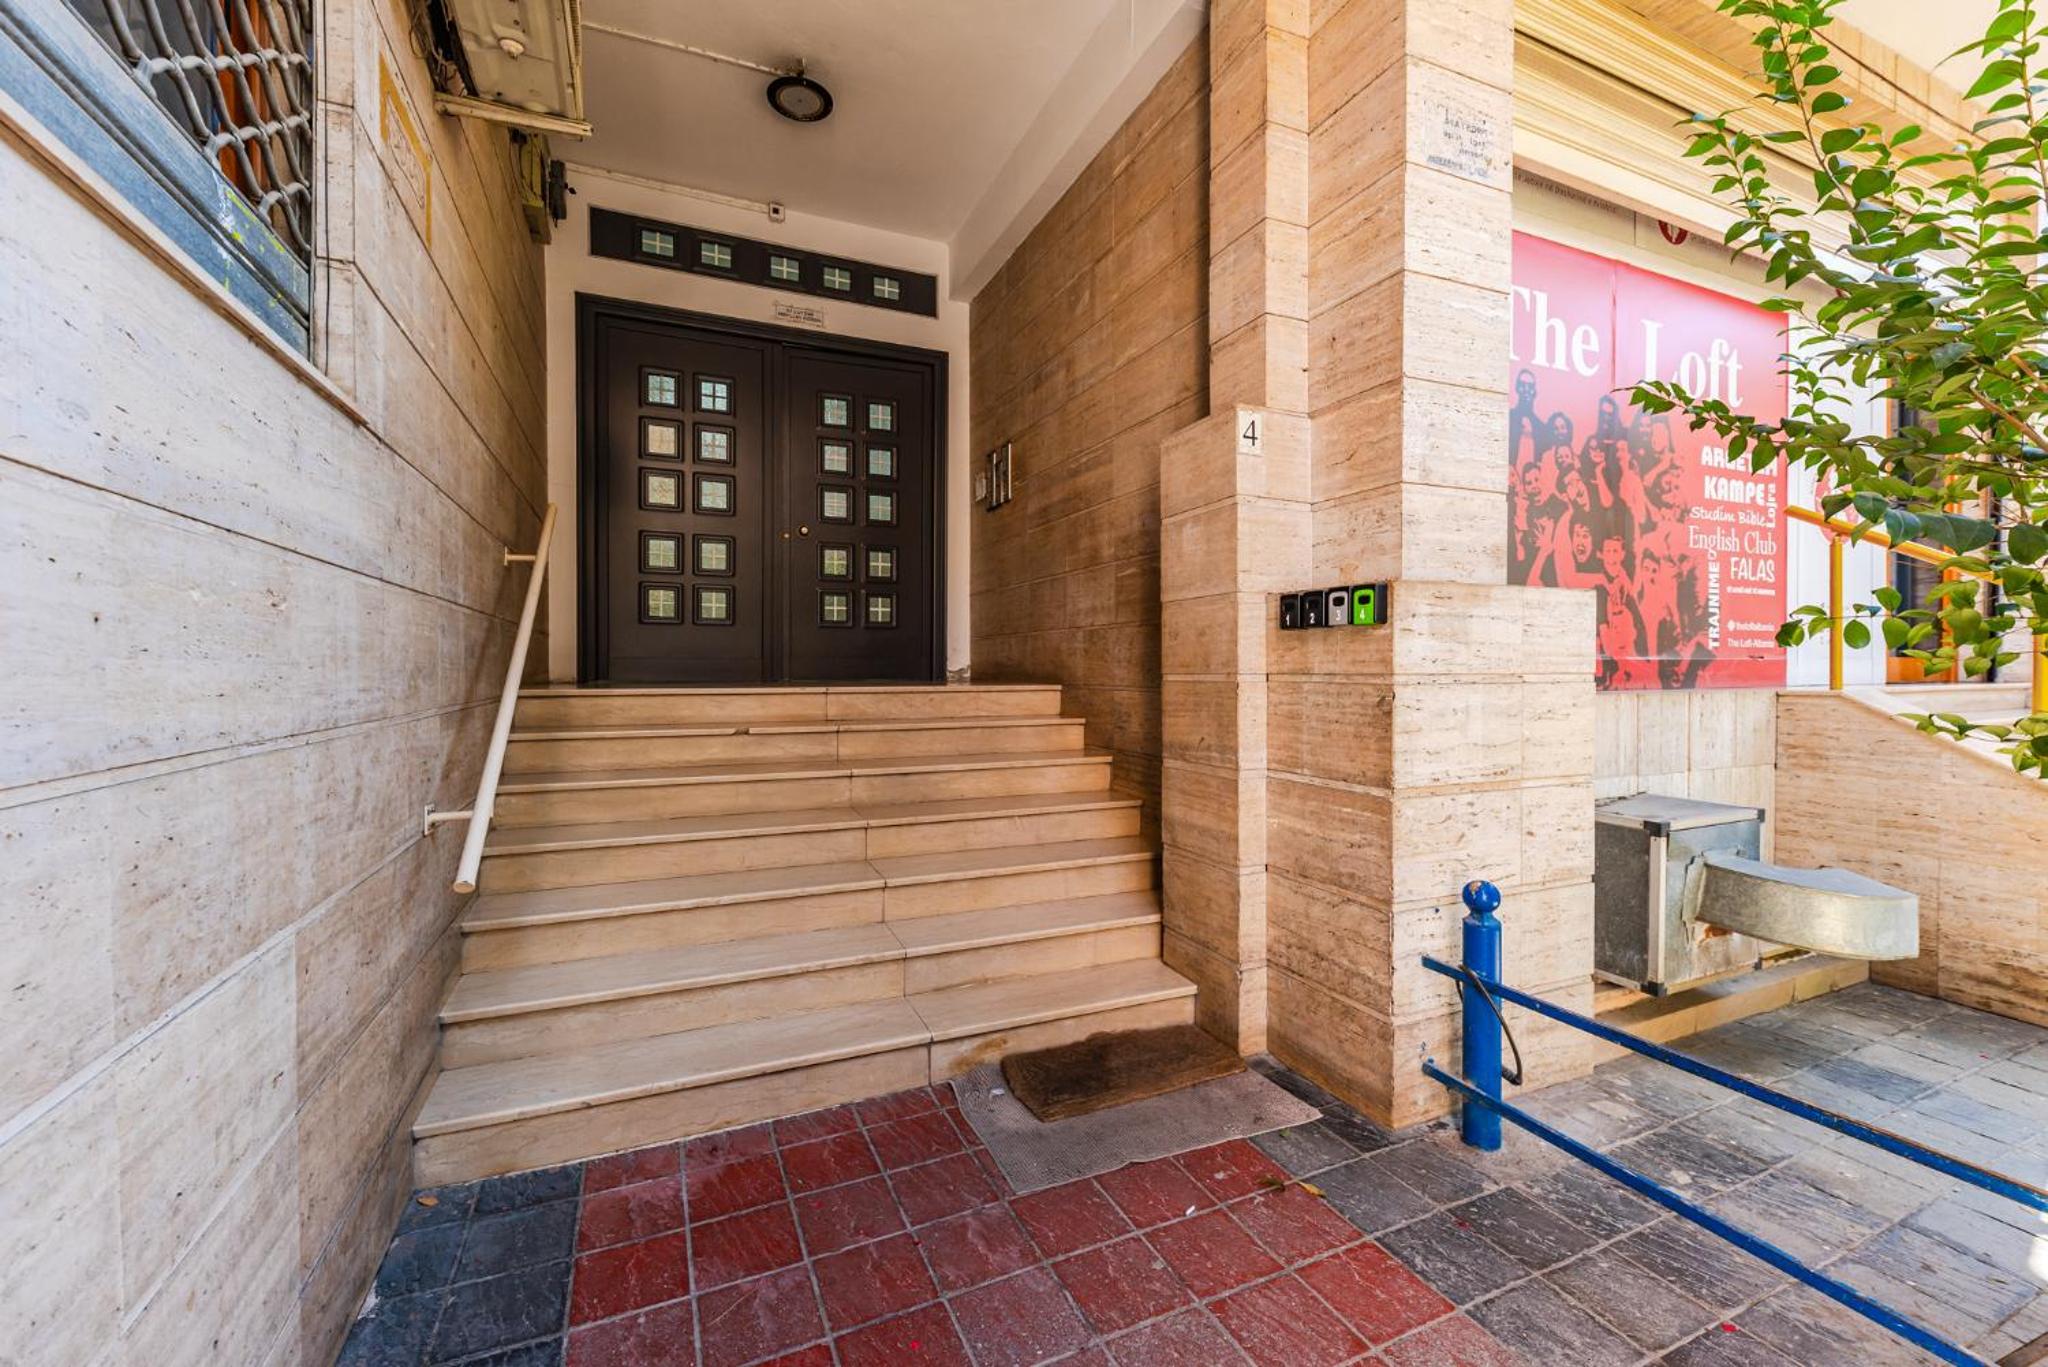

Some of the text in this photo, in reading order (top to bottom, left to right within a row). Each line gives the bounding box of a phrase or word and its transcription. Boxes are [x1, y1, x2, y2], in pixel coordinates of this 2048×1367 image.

[1509, 285, 1744, 408] The Loft
[1243, 420, 1258, 446] 4
[1701, 445, 1778, 477] ARETM
[1704, 475, 1765, 506] KAMPE
[1688, 525, 1776, 559] English Club
[1730, 558, 1775, 583] FALAS
[1309, 612, 1315, 624] 2
[1335, 609, 1342, 621] 3
[1359, 608, 1365, 620] 4
